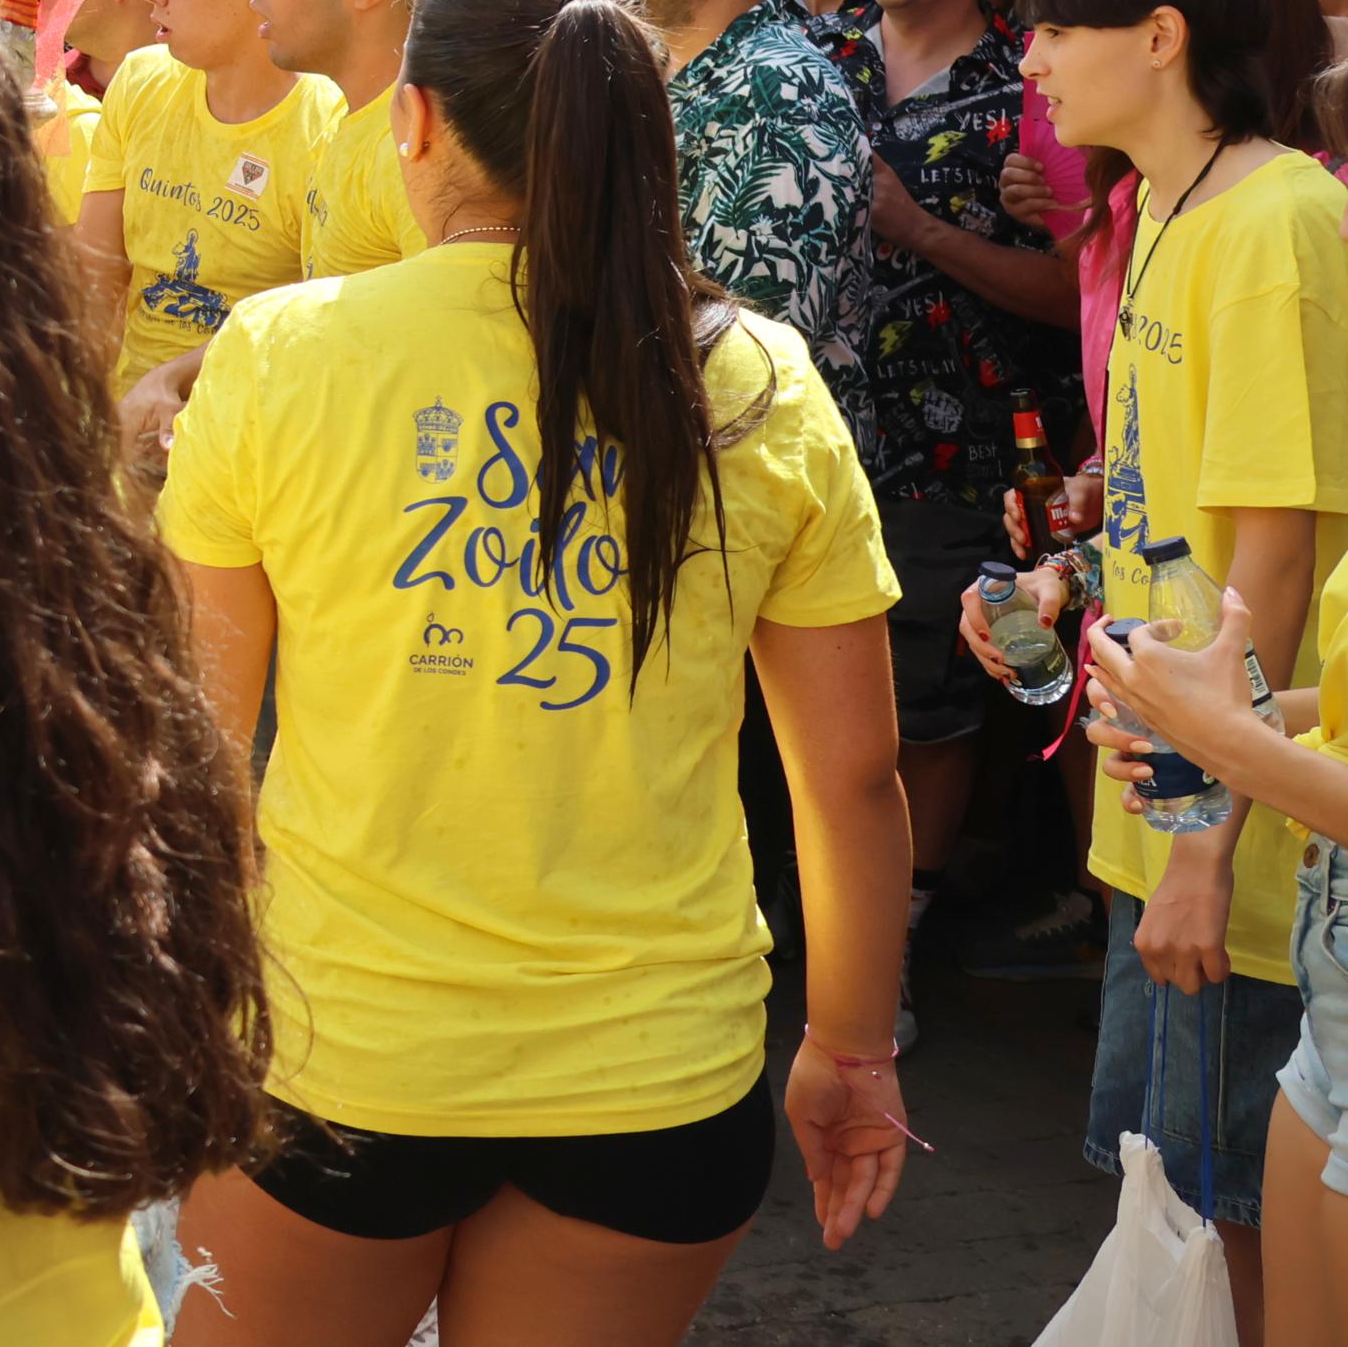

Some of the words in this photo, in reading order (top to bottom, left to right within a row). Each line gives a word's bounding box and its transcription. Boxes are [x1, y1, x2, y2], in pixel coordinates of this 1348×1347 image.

[957, 108, 1007, 132] YES!
[140, 167, 202, 212] Quintos
[207, 196, 261, 231] 2025
[903, 290, 944, 320] YES!
[392, 496, 631, 612] Zoilo
[409, 651, 474, 669] CARRIÓN
[437, 668, 467, 676] CONDES
[496, 608, 618, 711] 25
